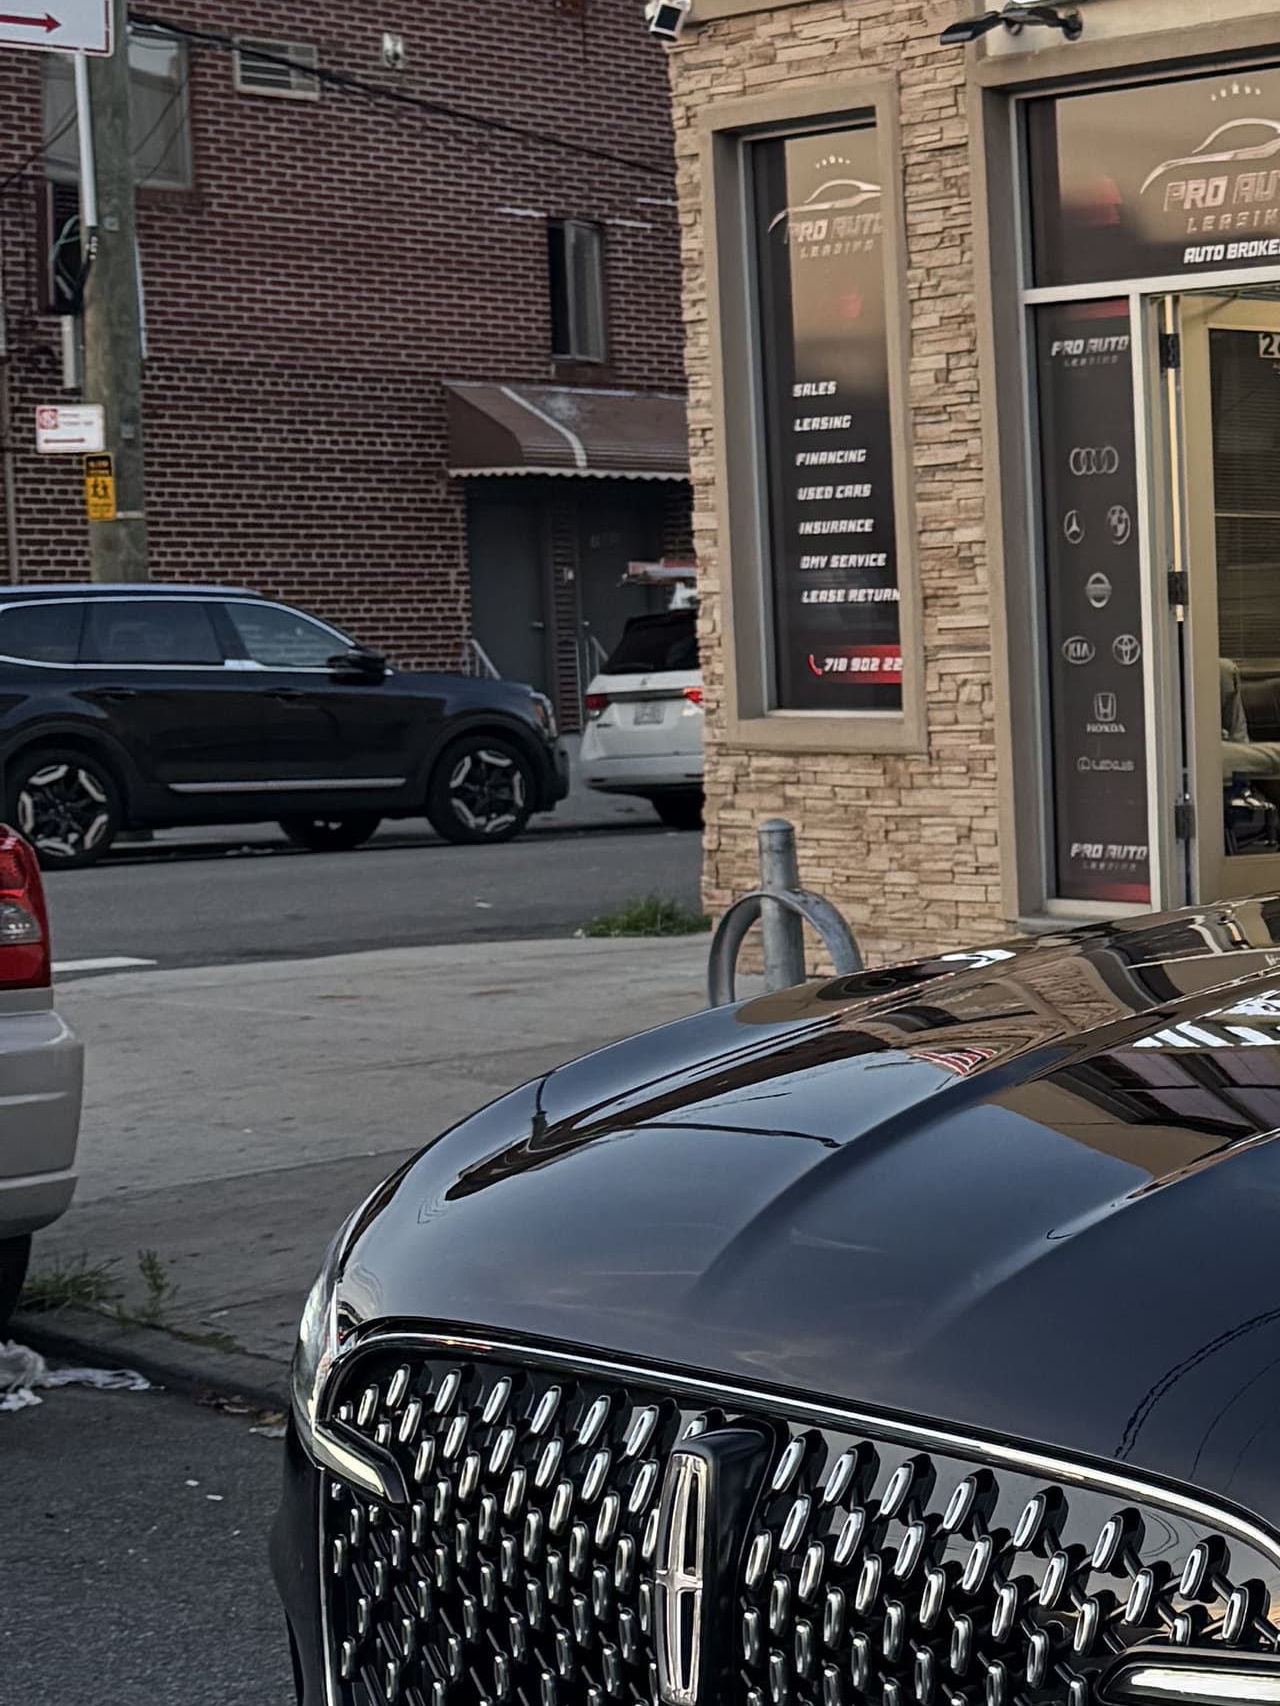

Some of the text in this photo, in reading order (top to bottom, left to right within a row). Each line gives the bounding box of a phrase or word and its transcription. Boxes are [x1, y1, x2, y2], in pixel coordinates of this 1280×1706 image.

[1163, 175, 1229, 212] PRO
[1183, 244, 1225, 264] AUTO
[1051, 335, 1130, 356] PRO AUTO
[792, 380, 837, 397] SALES
[793, 414, 853, 432] LEASING
[795, 448, 867, 466] FINANCING
[797, 483, 872, 501] USED CARS
[798, 518, 874, 535] INSURANCE
[799, 552, 888, 570] DMV SERVICE
[801, 589, 846, 604] LEASE
[1067, 642, 1089, 658] KIA
[1086, 723, 1127, 734] HONDA
[1069, 843, 1149, 861] PRO AUTO
